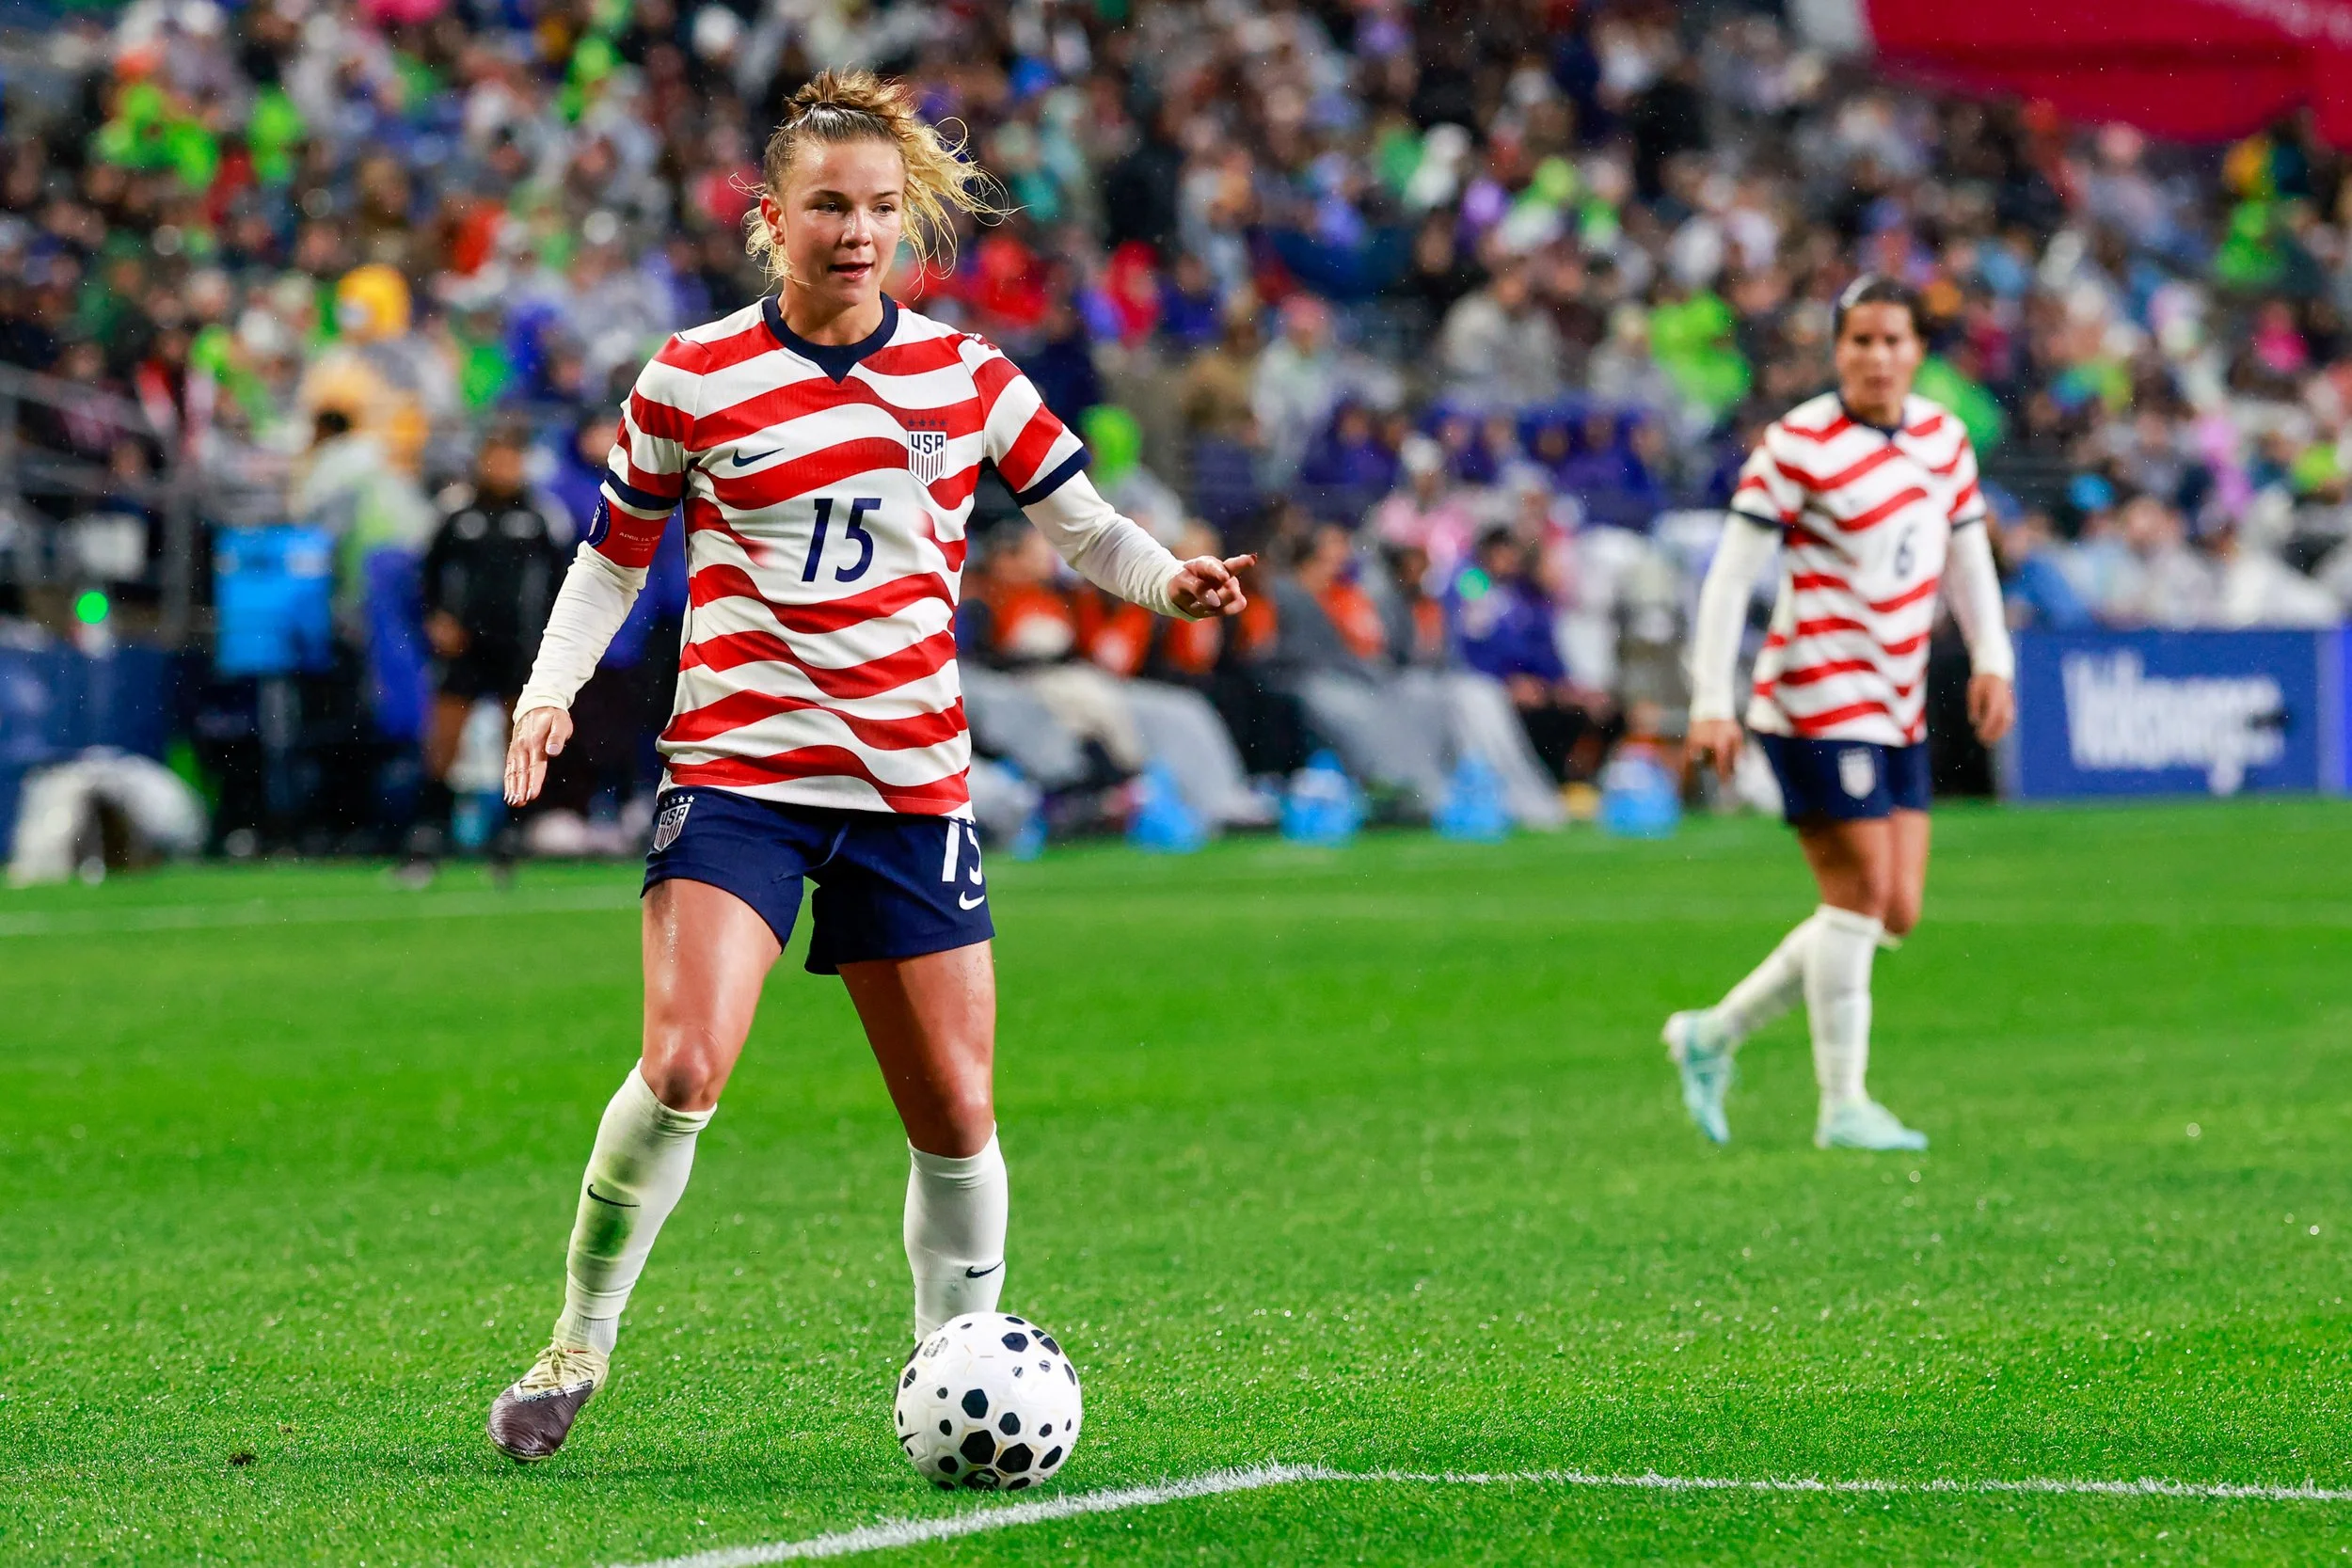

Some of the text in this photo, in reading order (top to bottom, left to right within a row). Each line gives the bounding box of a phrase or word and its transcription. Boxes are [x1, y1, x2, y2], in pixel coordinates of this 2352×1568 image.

[911, 434, 944, 454] USA
[802, 498, 882, 583] 15
[1894, 520, 1916, 579] 6
[660, 806, 687, 826] USA
